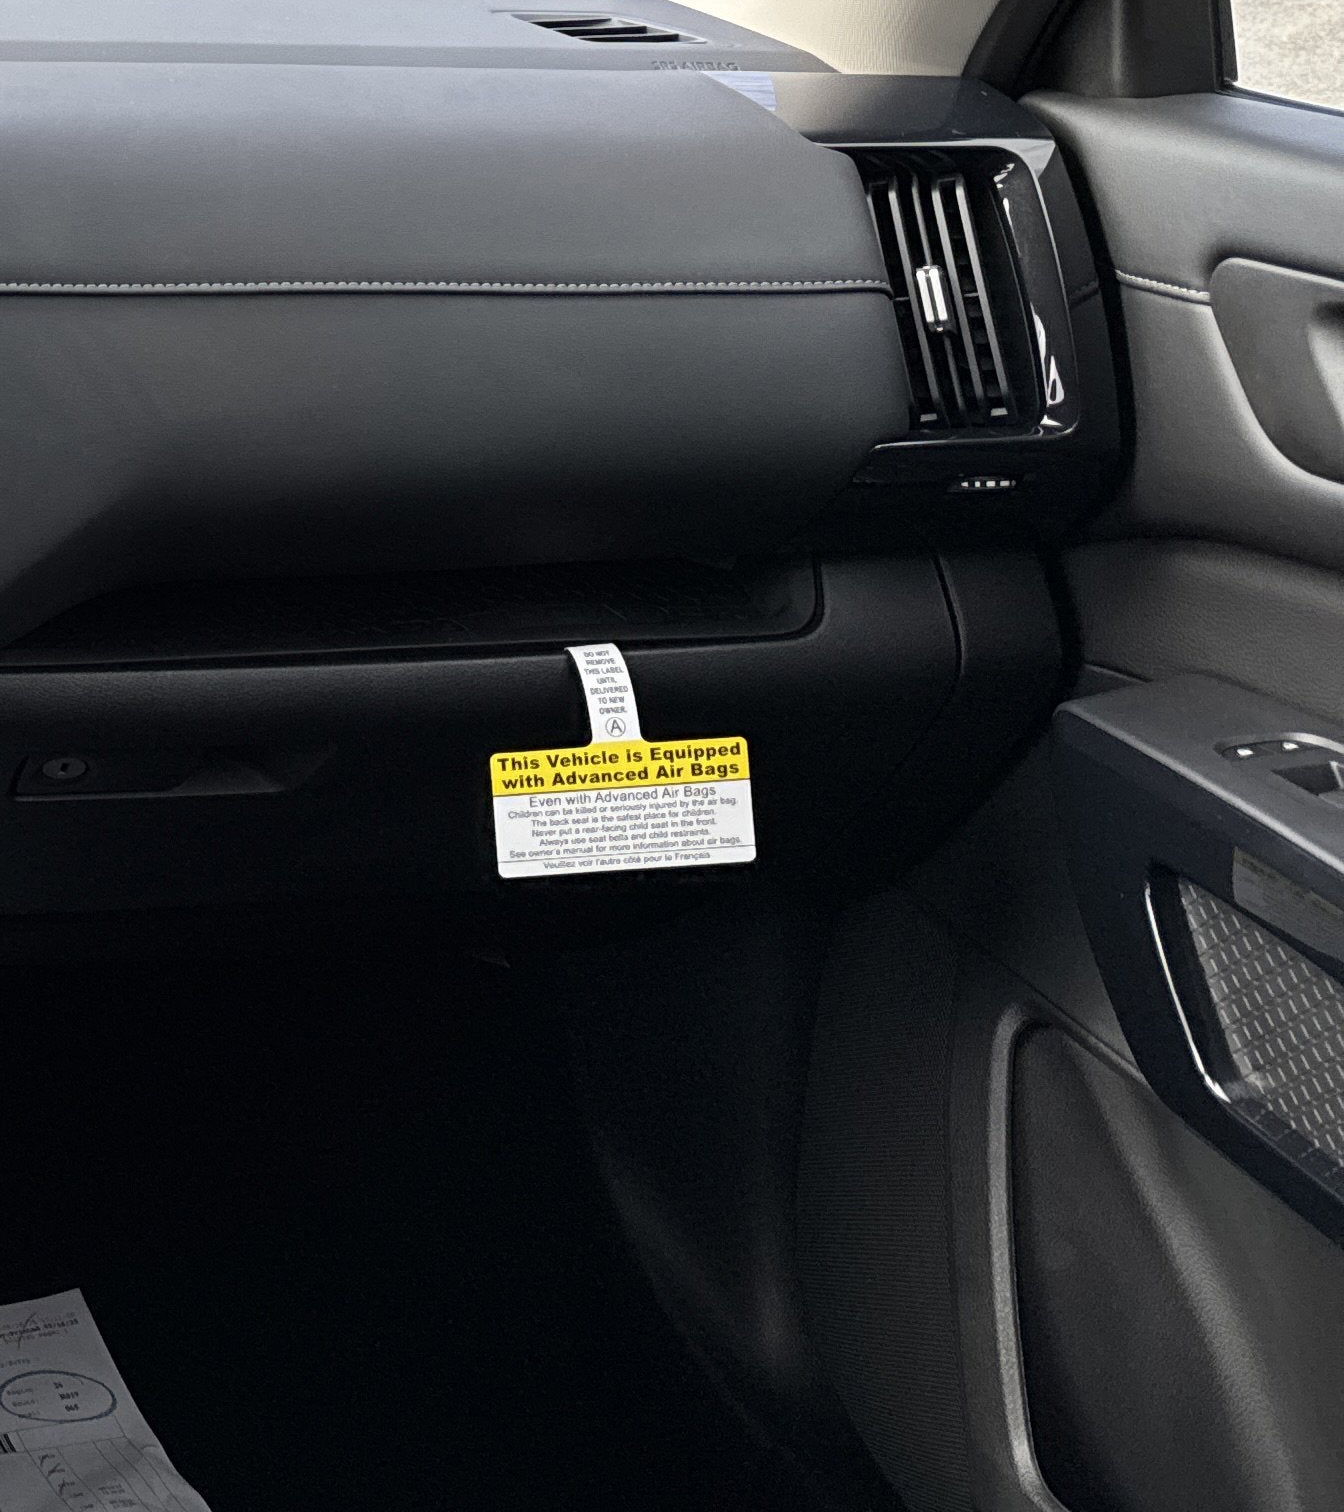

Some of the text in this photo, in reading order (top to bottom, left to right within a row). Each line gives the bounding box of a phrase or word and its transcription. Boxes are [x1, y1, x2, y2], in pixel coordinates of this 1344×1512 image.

[602, 667, 624, 675] LABEL
[590, 686, 629, 695] DELIVERED
[609, 696, 625, 704] NEW
[497, 741, 741, 772] This Vehicle is Equipped
[502, 762, 739, 790] with Advanced Air Bags
[529, 785, 717, 808] Even with Advanced Air Bags
[508, 809, 543, 819] Children
[545, 809, 561, 817] can
[563, 807, 573, 815] be
[575, 806, 597, 814] killed
[649, 800, 677, 810] injured
[680, 799, 690, 809] by
[692, 798, 705, 806] the
[707, 798, 718, 806] air
[531, 819, 547, 827] The
[549, 817, 569, 826] back
[571, 816, 589, 825] seat
[592, 816, 599, 824] is
[601, 814, 614, 822] the
[616, 812, 642, 822] safest
[643, 811, 666, 821] place
[668, 810, 679, 818] for
[531, 829, 556, 837] Never
[559, 828, 573, 837] put
[582, 824, 627, 833] rear-facing
[629, 822, 648, 831] child
[651, 821, 669, 829] seat
[671, 819, 679, 828] in
[680, 819, 694, 827] the
